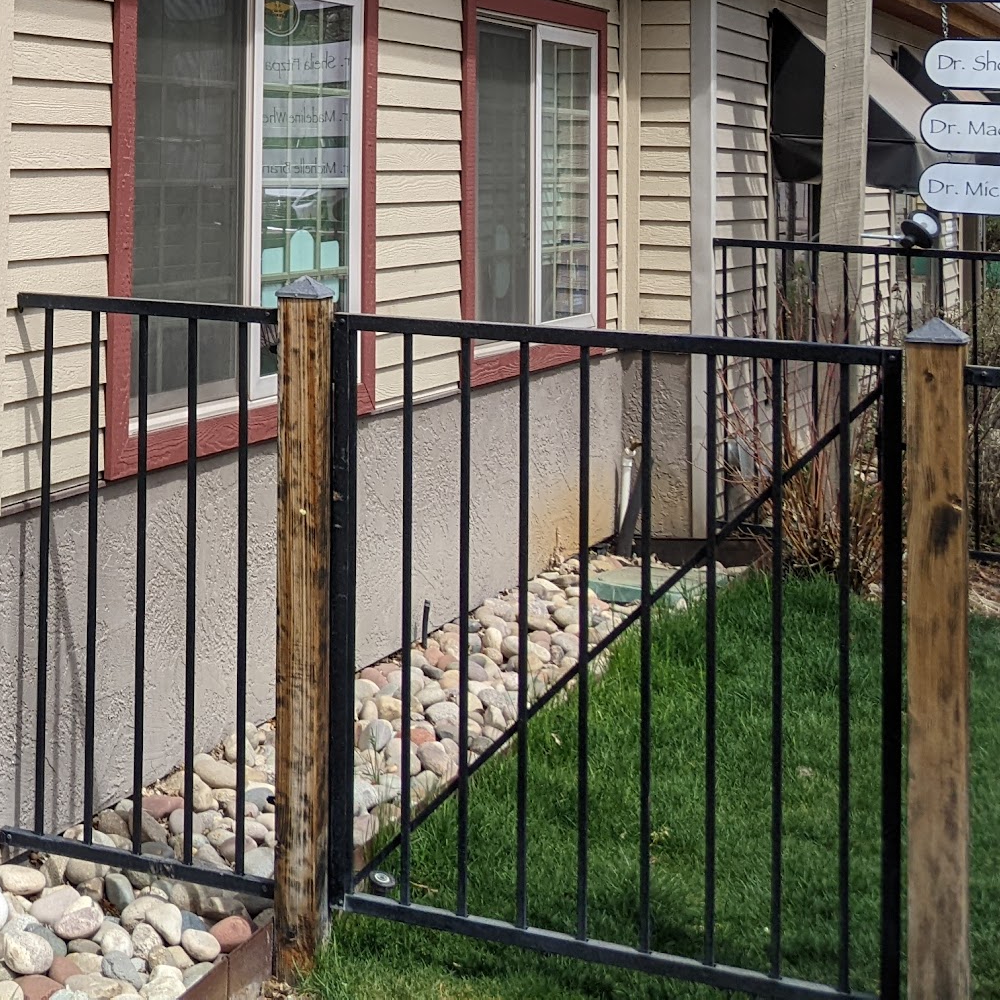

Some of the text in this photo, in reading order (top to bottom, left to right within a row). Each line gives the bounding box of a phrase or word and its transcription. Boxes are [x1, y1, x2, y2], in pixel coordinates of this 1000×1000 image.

[938, 54, 965, 70] Dr.
[930, 119, 961, 135] Dr.
[928, 179, 1000, 197] Dr. Mic
